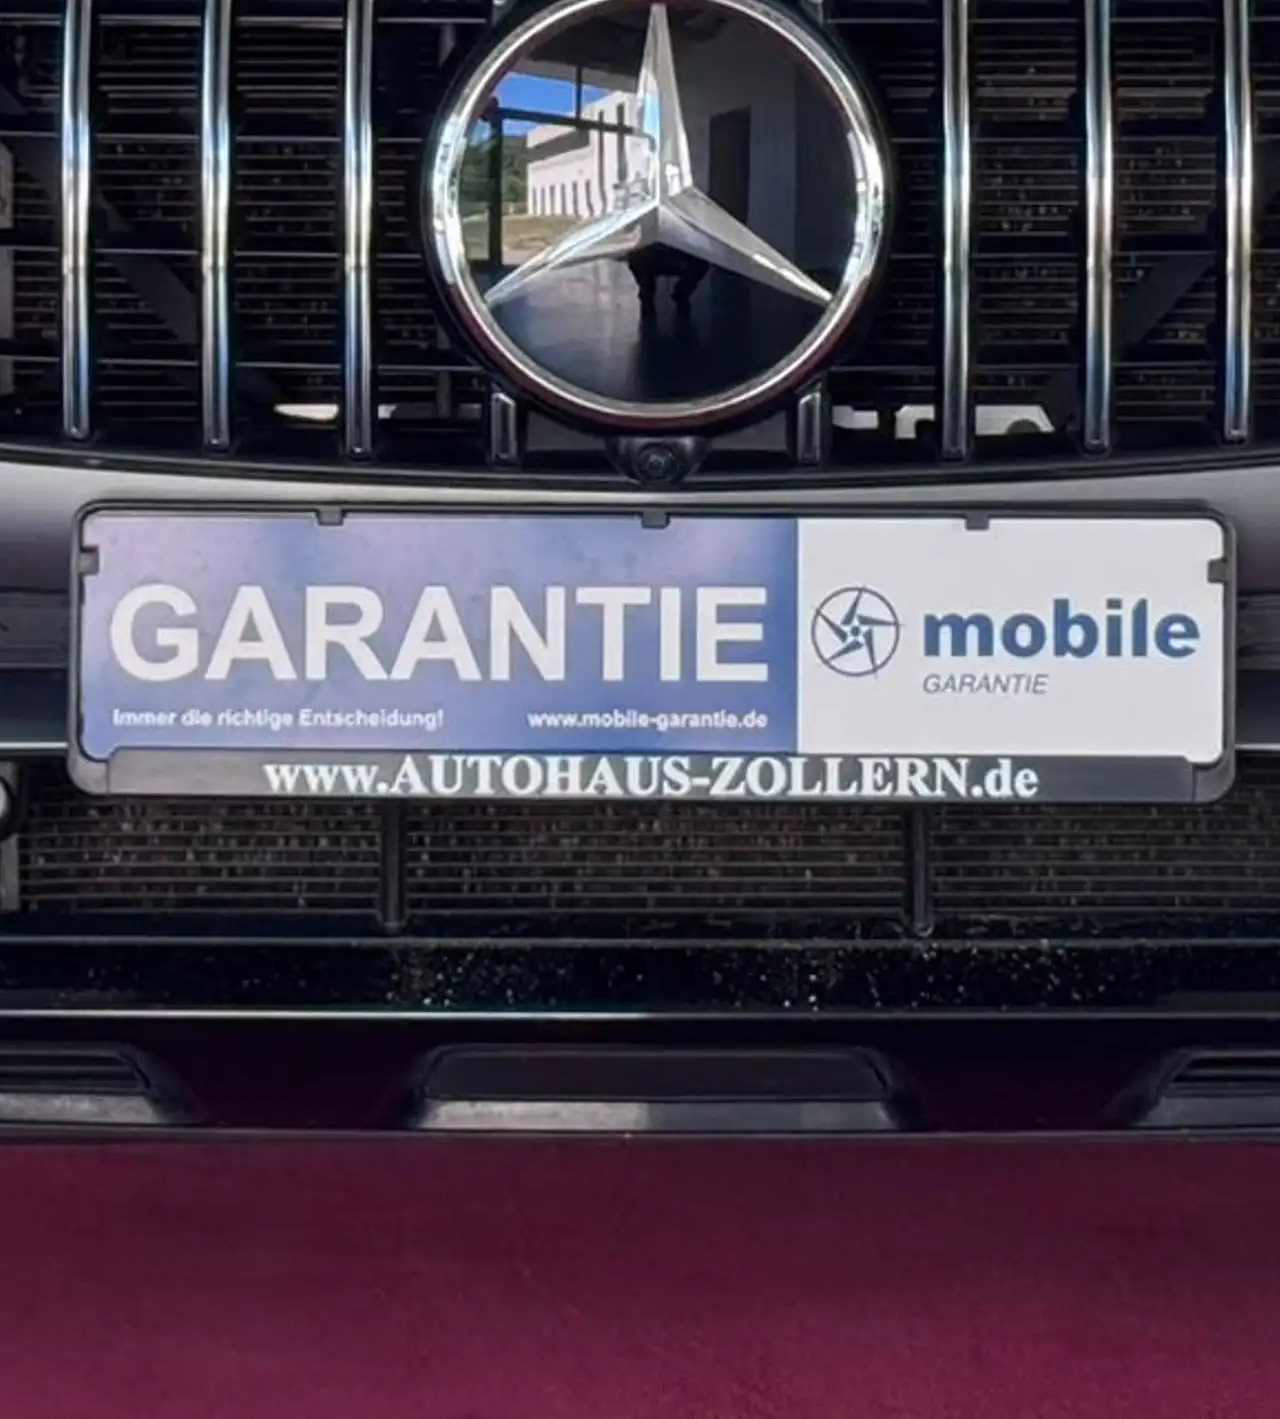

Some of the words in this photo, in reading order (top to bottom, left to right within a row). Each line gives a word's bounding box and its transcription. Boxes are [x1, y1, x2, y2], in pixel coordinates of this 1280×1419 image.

[109, 583, 770, 683] GARANTIE
[923, 598, 1201, 659] mobile
[922, 672, 1050, 695] GARANTIE
[113, 709, 177, 727] Immer
[181, 708, 213, 727] die
[217, 708, 294, 731] richtige
[298, 708, 445, 731] Entscheidung!
[526, 708, 769, 731] www.mobile-garantie.de
[261, 755, 1040, 798] www.AUTOHAUS-ZOLLERN.de
